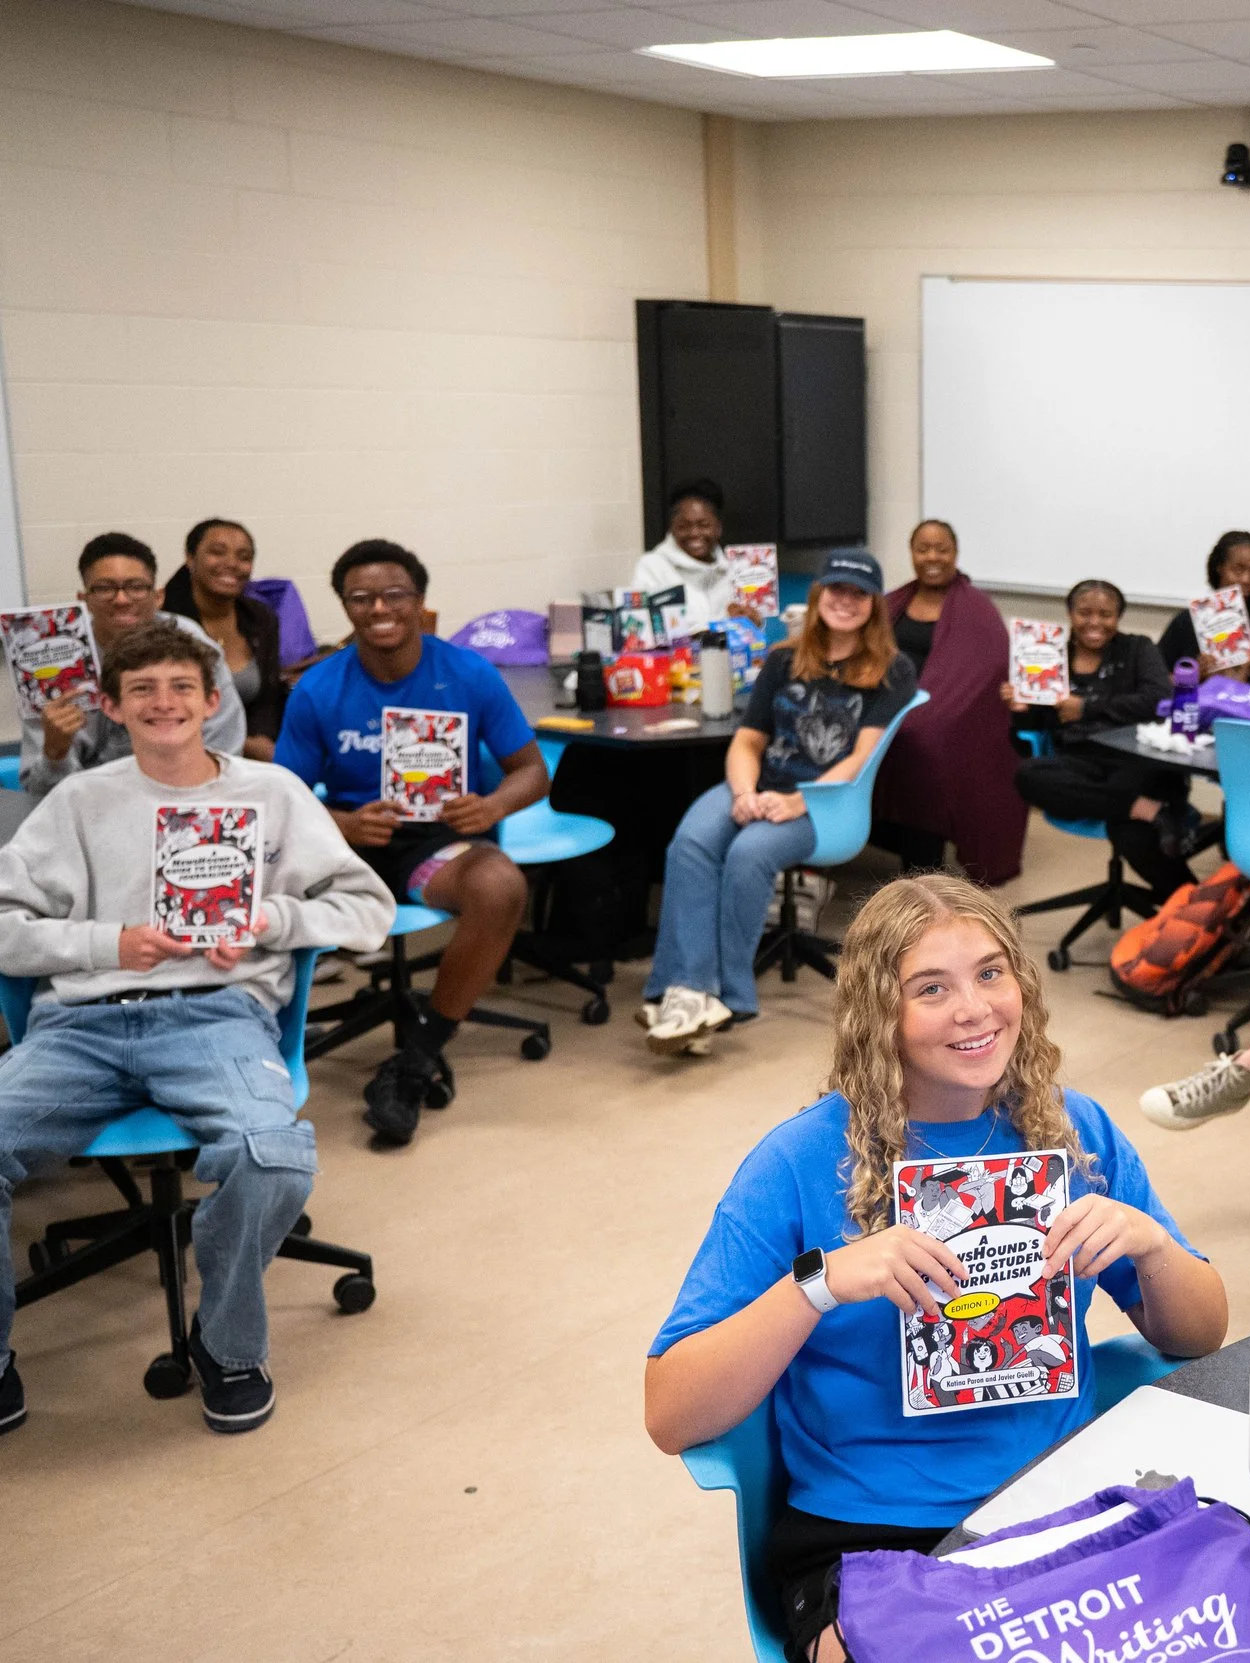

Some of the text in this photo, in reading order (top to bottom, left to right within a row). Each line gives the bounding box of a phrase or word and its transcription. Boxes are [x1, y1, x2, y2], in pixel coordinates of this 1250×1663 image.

[979, 1235, 988, 1246] A
[968, 1251, 1043, 1275] TO STUDEN
[954, 1266, 1031, 1288] URNALISM
[951, 1299, 995, 1313] EDITION 1.1
[946, 1379, 965, 1387] Katina
[998, 1373, 1015, 1381] Javier
[956, 1597, 1014, 1632] THE
[970, 1574, 1145, 1661] DETROIT
[1144, 1631, 1207, 1663] OOM
